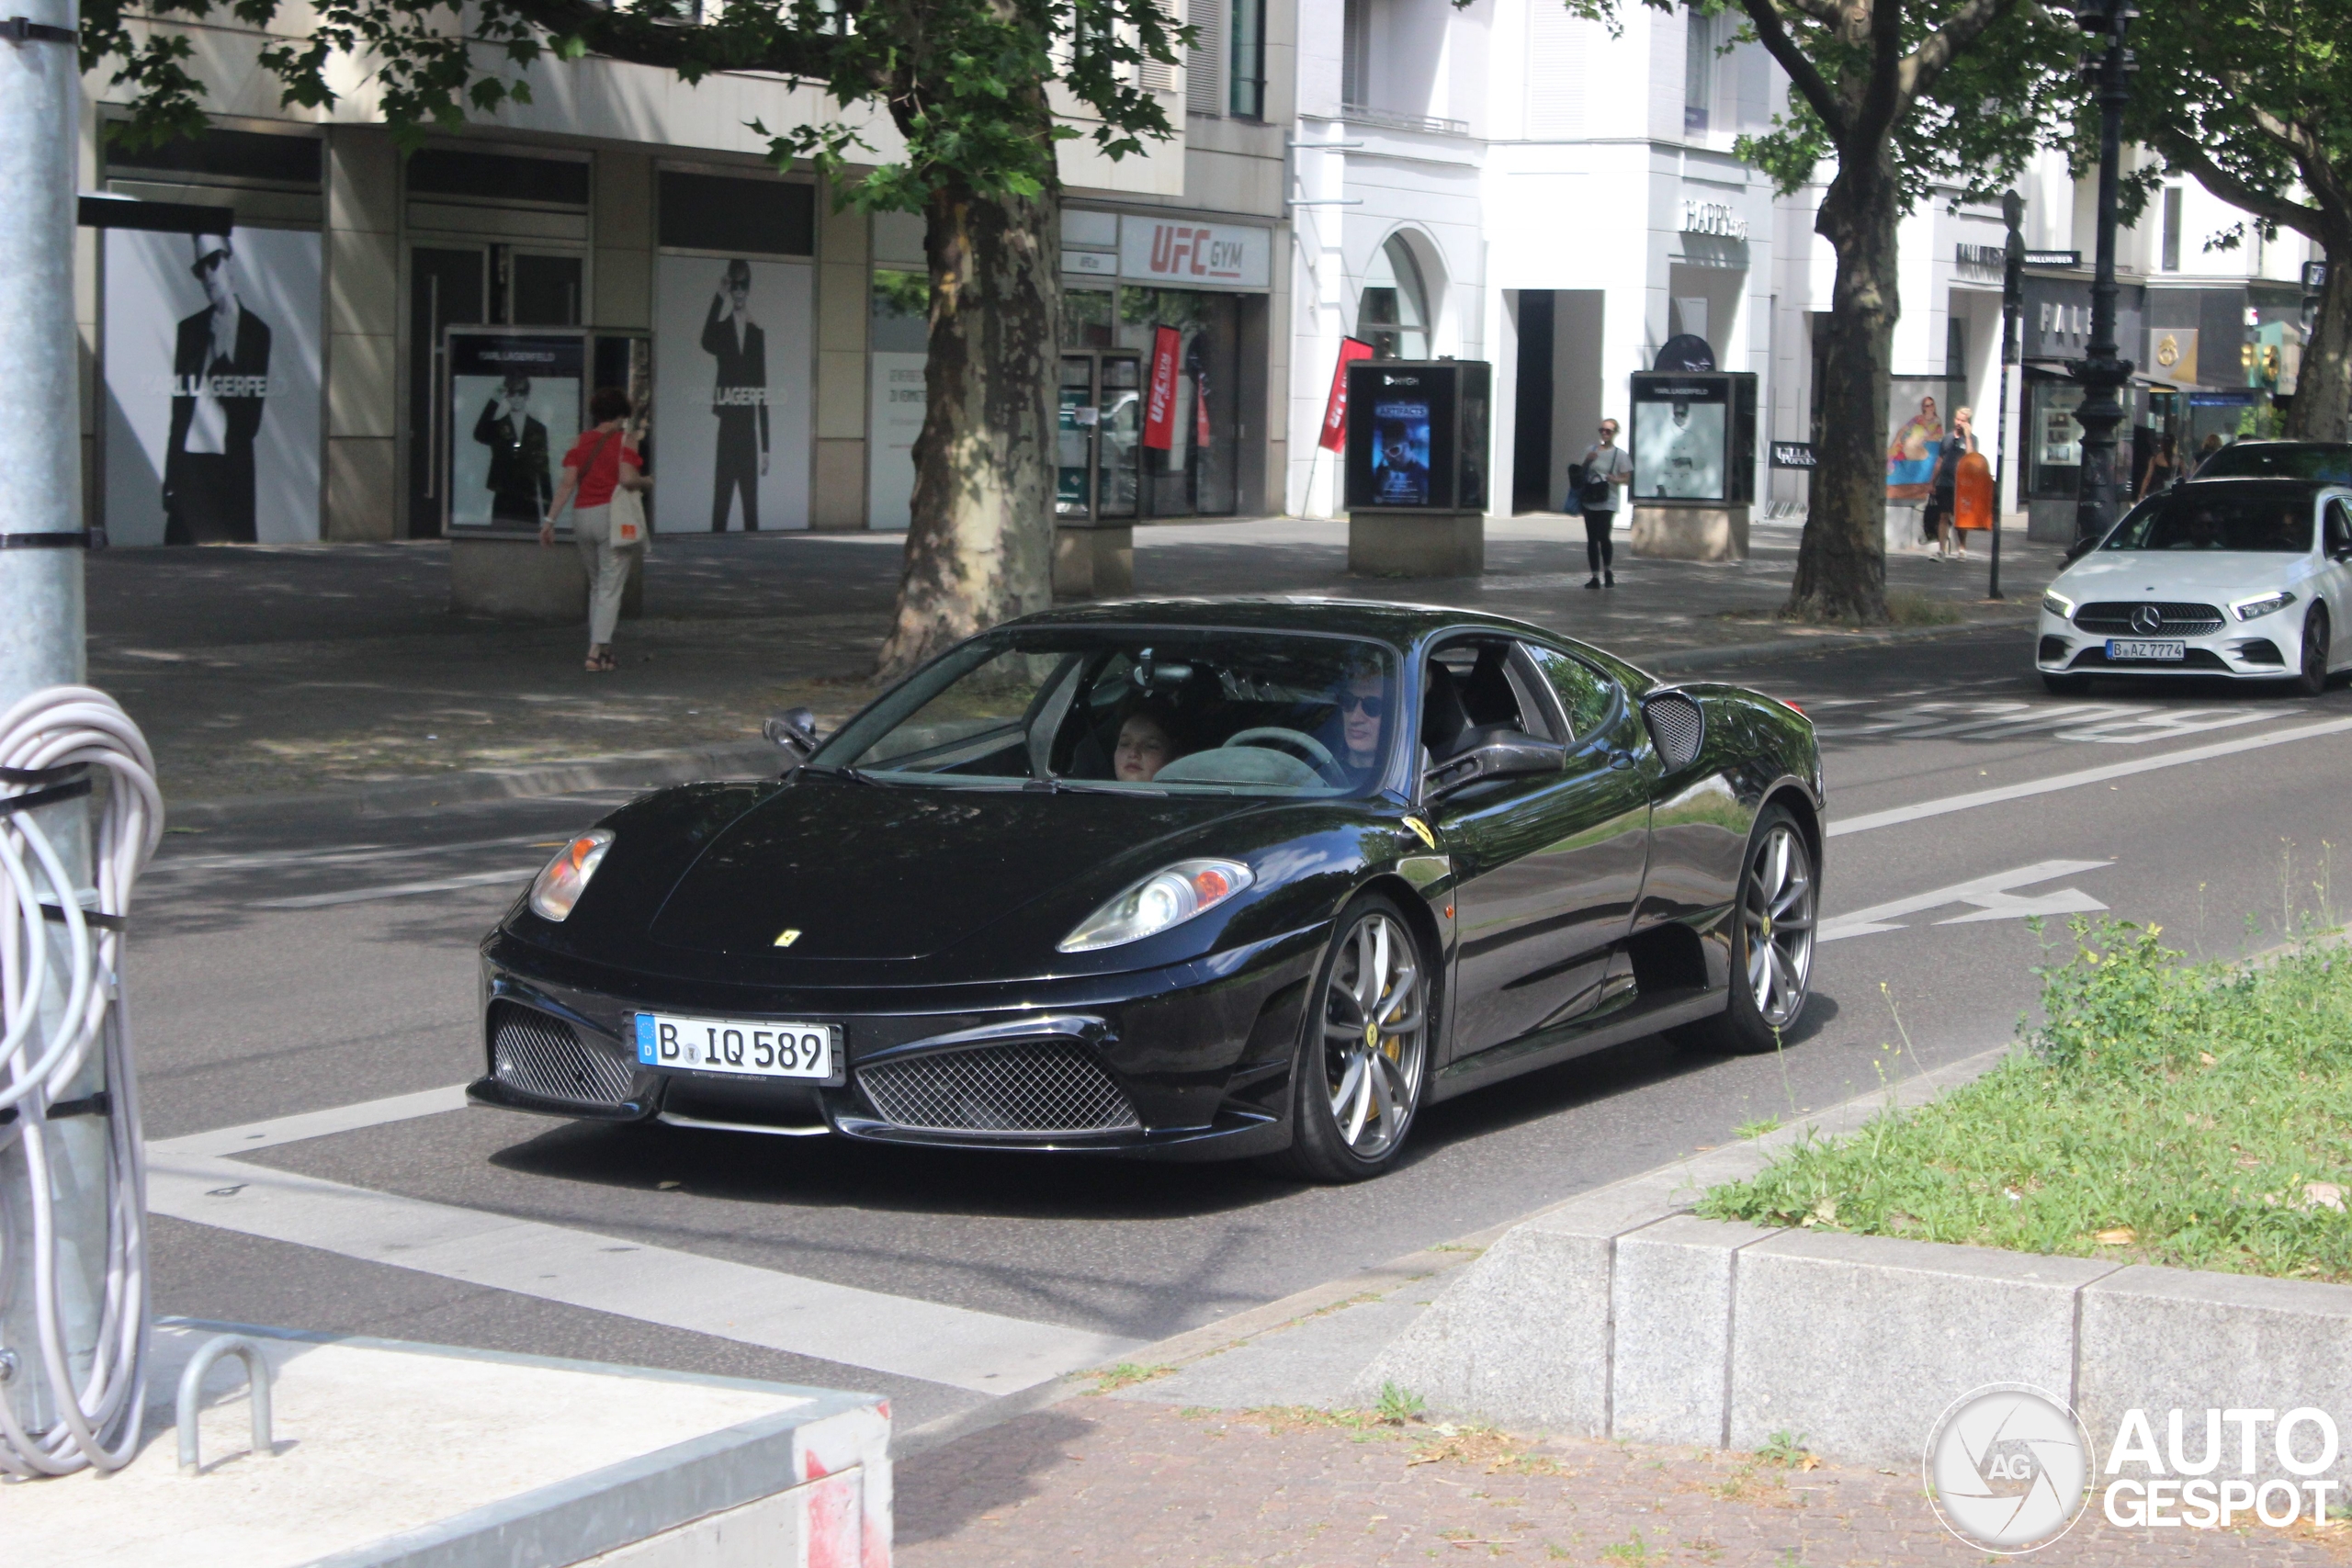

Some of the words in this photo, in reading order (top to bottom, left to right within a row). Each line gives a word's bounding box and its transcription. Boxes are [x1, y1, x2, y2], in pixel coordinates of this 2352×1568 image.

[1682, 199, 1734, 236] HAPPY
[1150, 225, 1211, 276] UFC
[1211, 241, 1243, 268] GYM
[2025, 254, 2074, 265] HALLHUBER
[1150, 378, 1167, 423] UFC
[2113, 643, 2122, 656] B
[2131, 644, 2149, 657] AZ
[2150, 644, 2182, 656] 7774
[644, 1046, 652, 1056] D
[660, 1023, 680, 1060] B
[705, 1028, 744, 1066] IQ
[753, 1031, 821, 1070] 589
